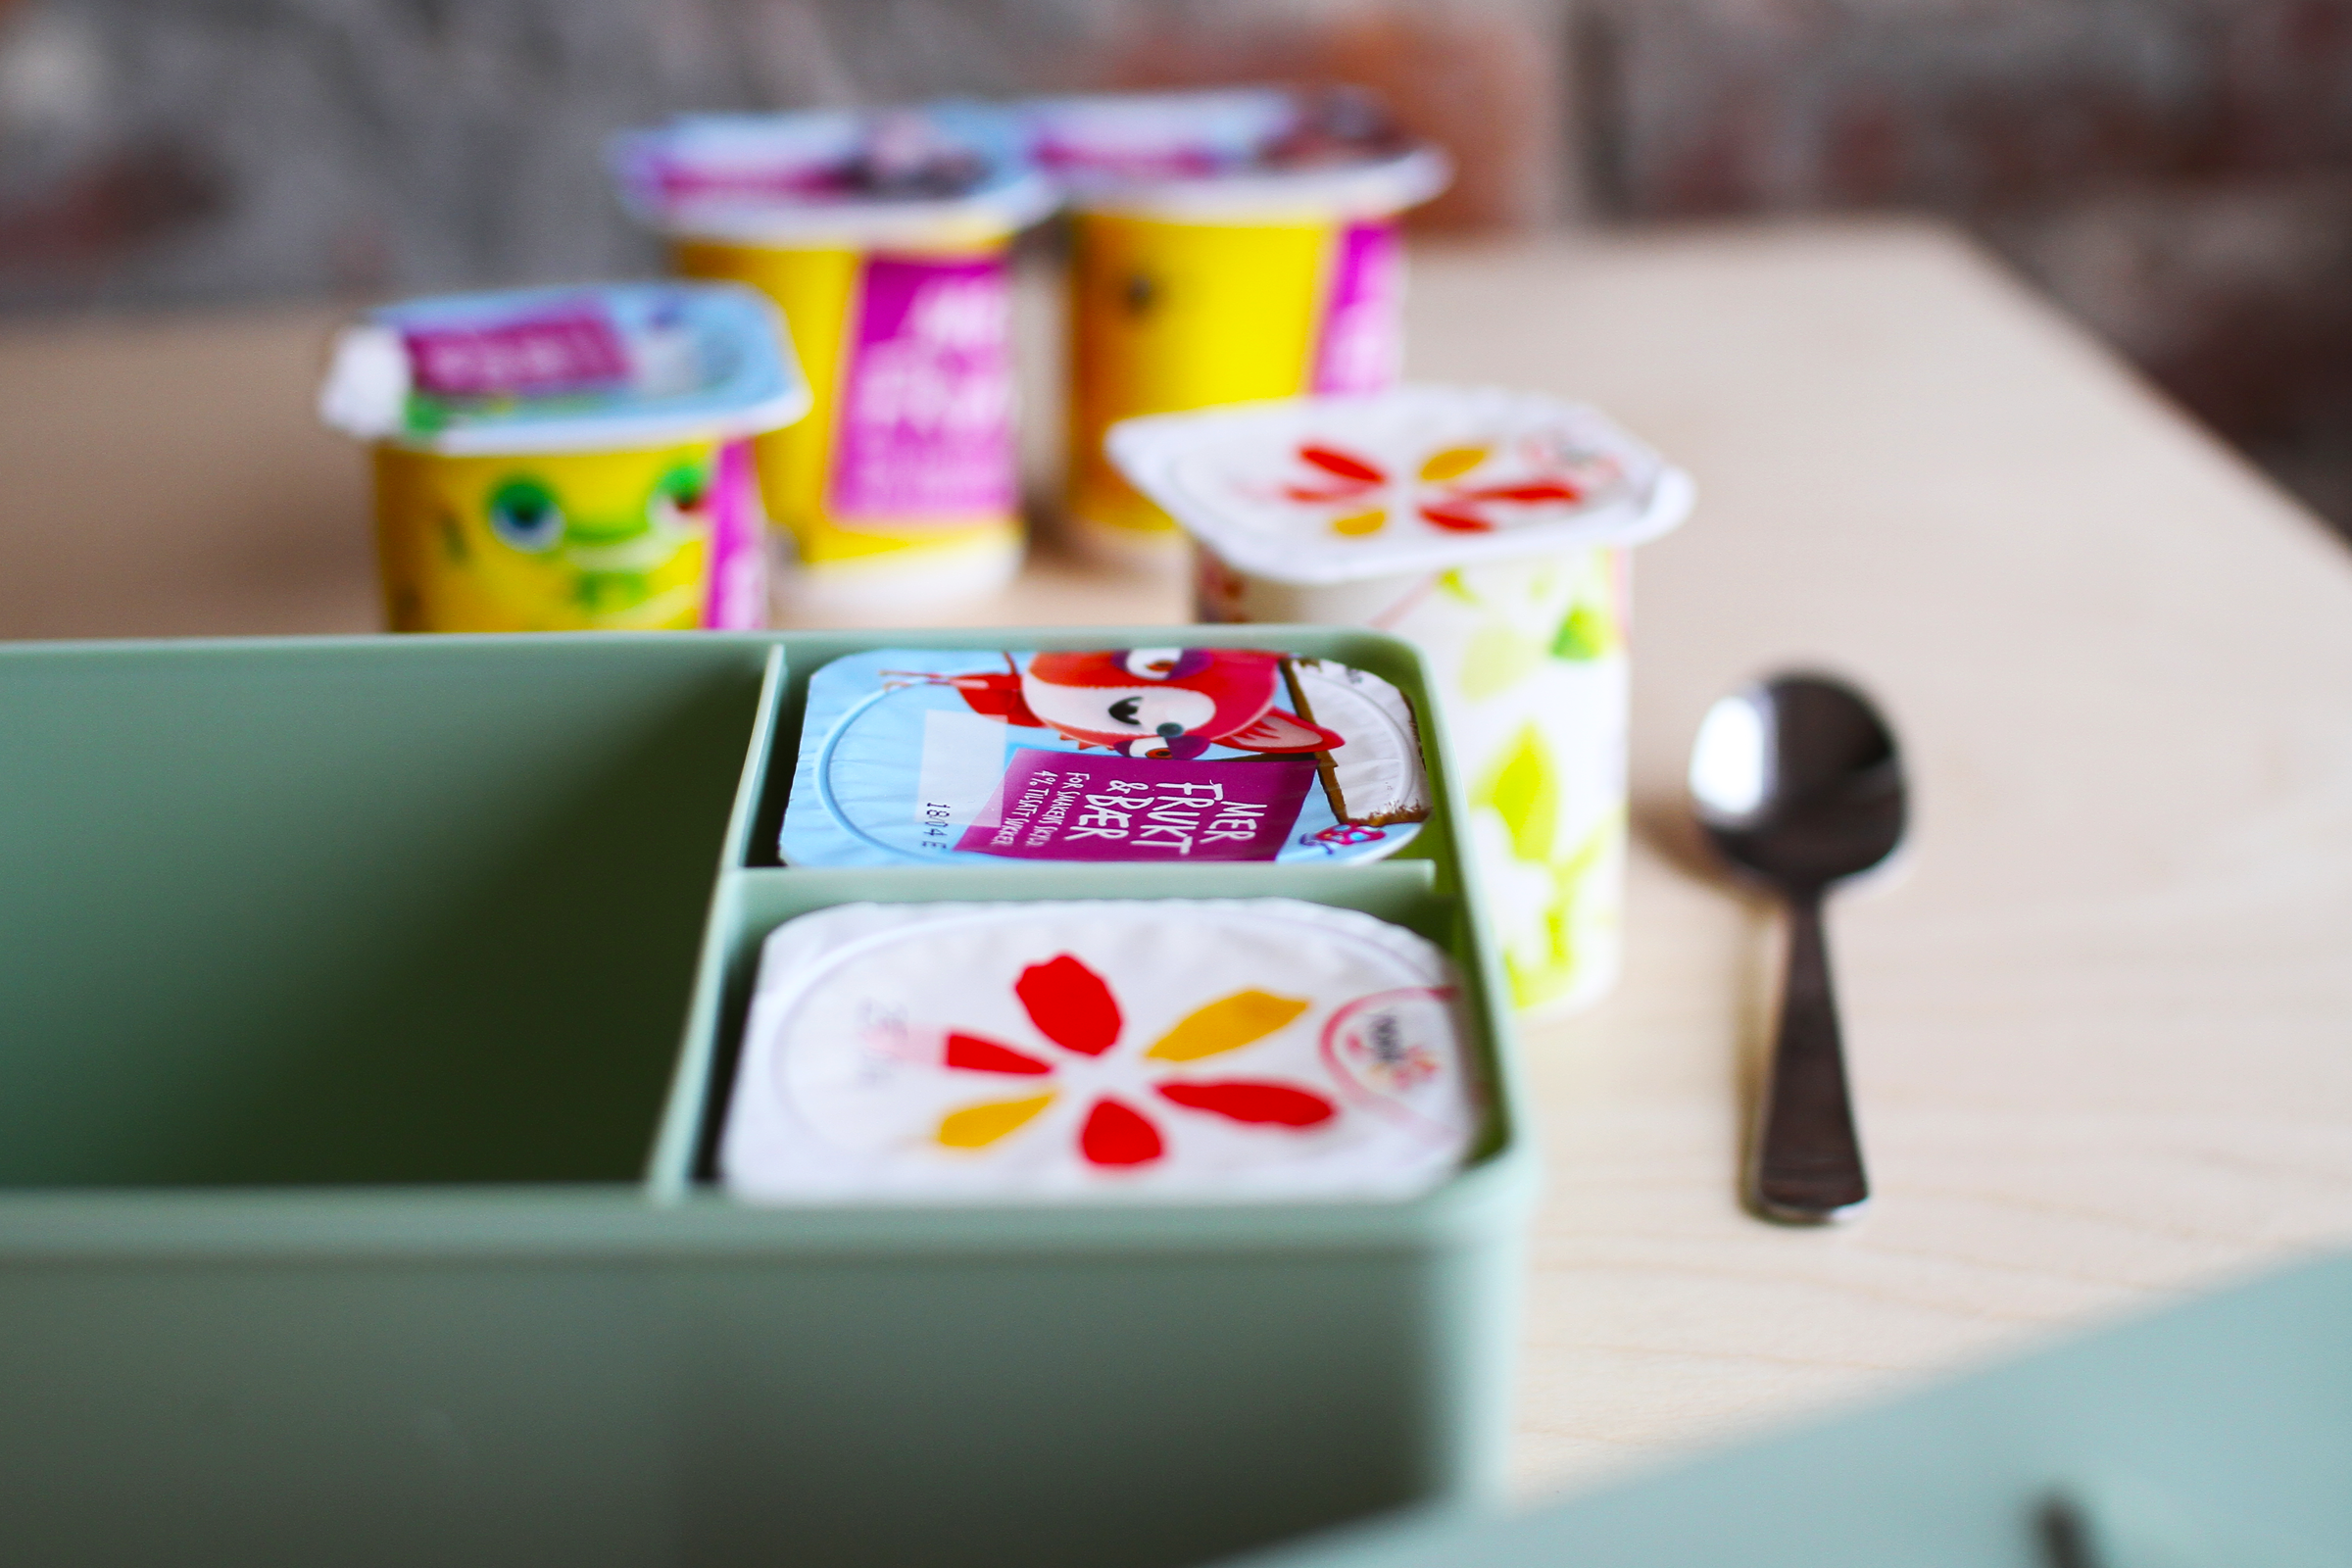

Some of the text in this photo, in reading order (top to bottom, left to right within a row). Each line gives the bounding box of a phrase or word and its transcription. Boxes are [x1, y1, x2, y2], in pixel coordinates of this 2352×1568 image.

[1029, 770, 1058, 786] 4%
[1062, 771, 1090, 789] FOR
[1011, 788, 1050, 817] TILSATT
[1038, 790, 1080, 825] SMAKENS
[1064, 780, 1154, 841] & BÆR
[1130, 780, 1224, 855] FRUKT
[1199, 801, 1268, 844] MER
